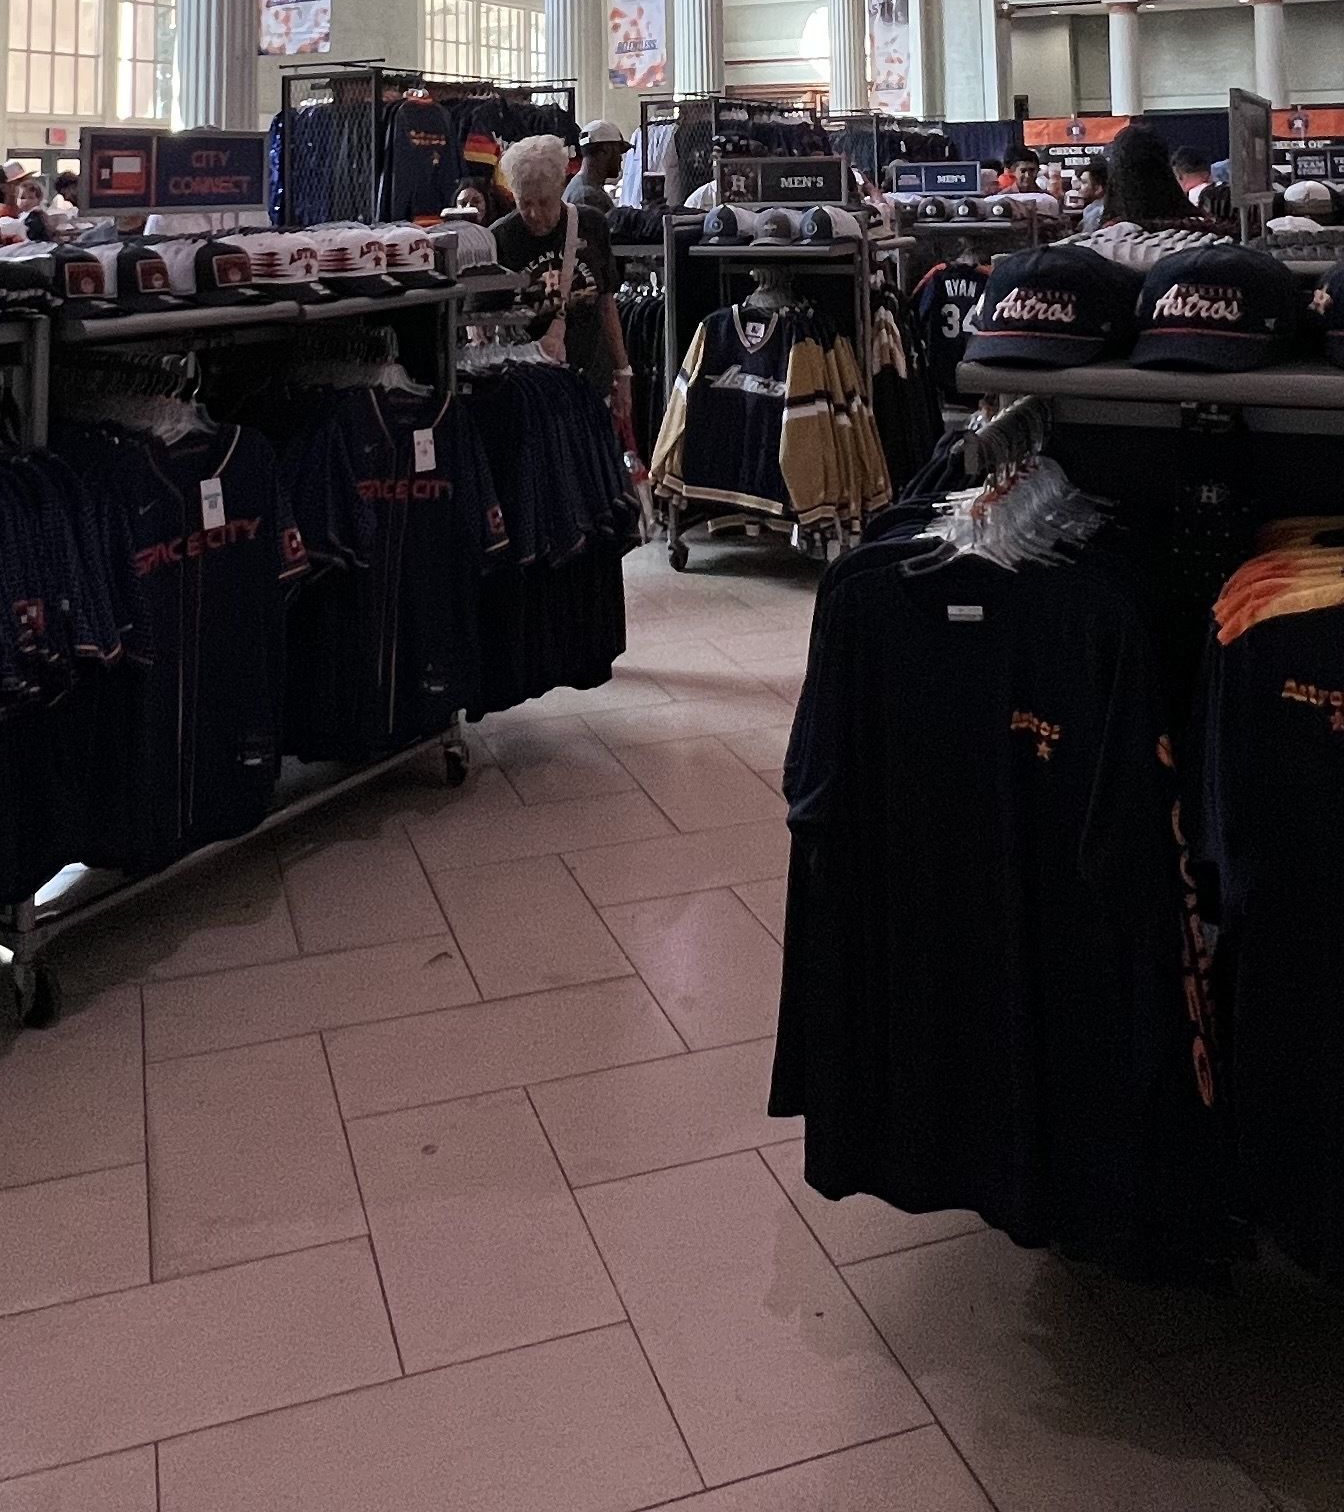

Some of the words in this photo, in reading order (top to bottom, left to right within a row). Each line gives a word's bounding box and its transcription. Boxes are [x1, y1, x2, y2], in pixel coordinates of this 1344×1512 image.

[190, 149, 230, 169] CITY
[168, 174, 252, 195] CONNECT
[780, 175, 824, 189] MEN'S
[945, 278, 977, 298] RYAN
[992, 287, 1076, 323] Astros
[1152, 283, 1241, 321] Astros
[132, 530, 207, 580] SPACE
